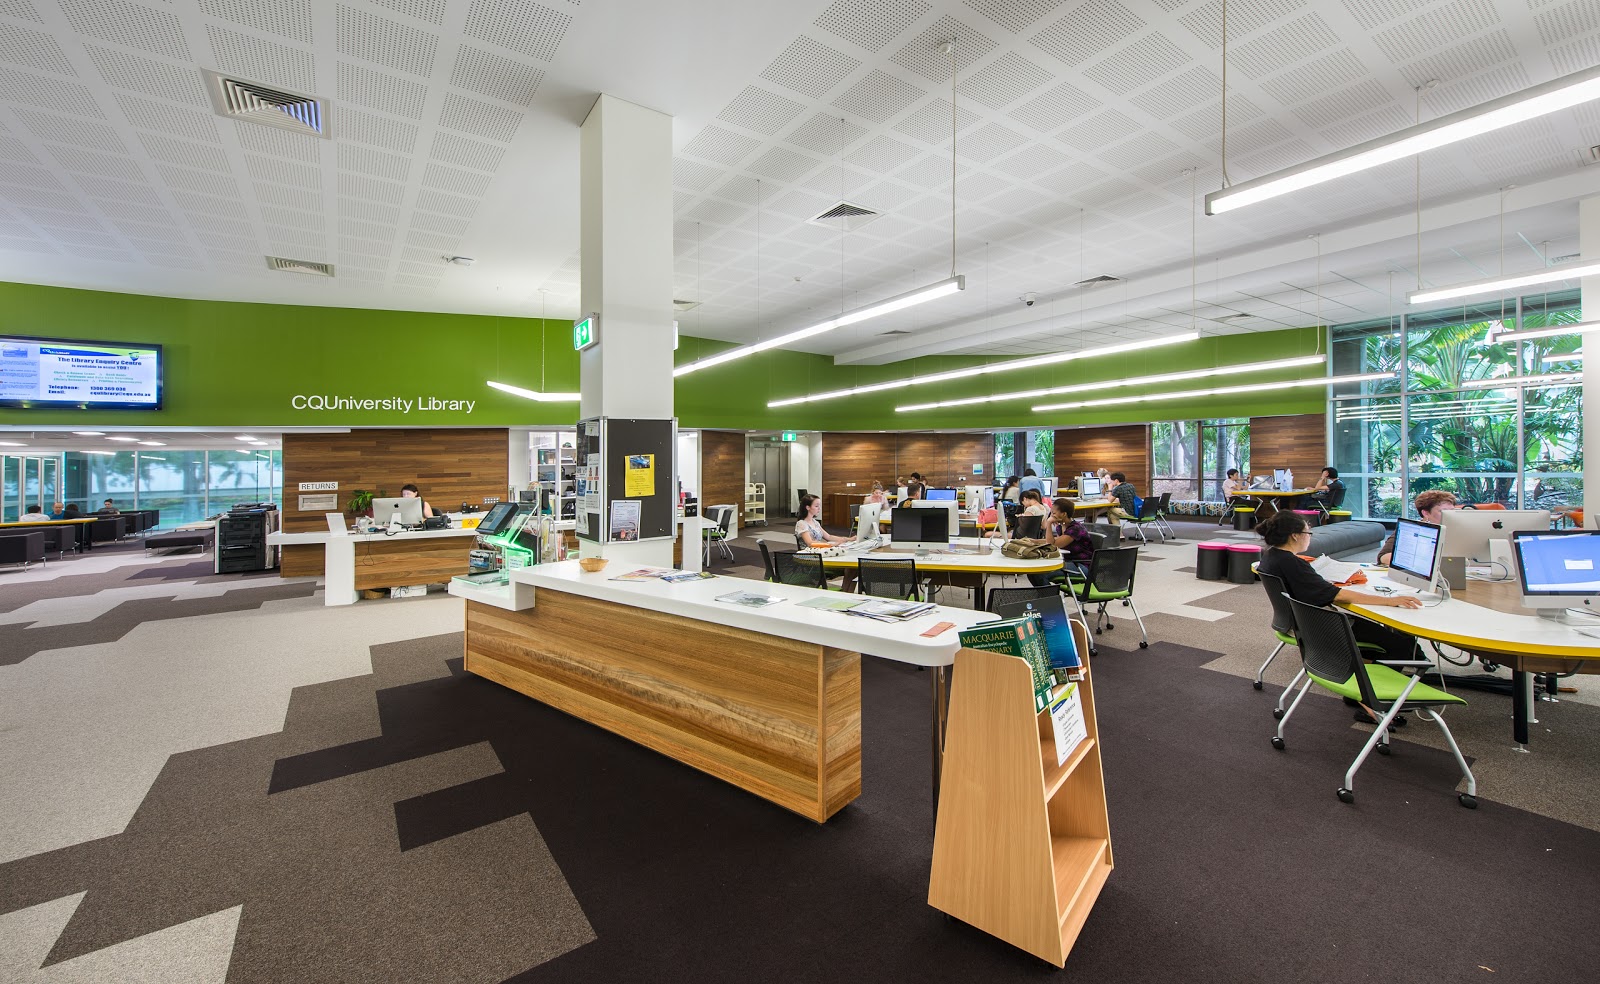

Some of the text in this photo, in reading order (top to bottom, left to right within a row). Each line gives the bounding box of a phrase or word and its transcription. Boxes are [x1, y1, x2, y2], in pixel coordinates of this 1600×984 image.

[292, 395, 476, 414] CQUniversity Library
[962, 630, 1014, 644] MACQUARIE
